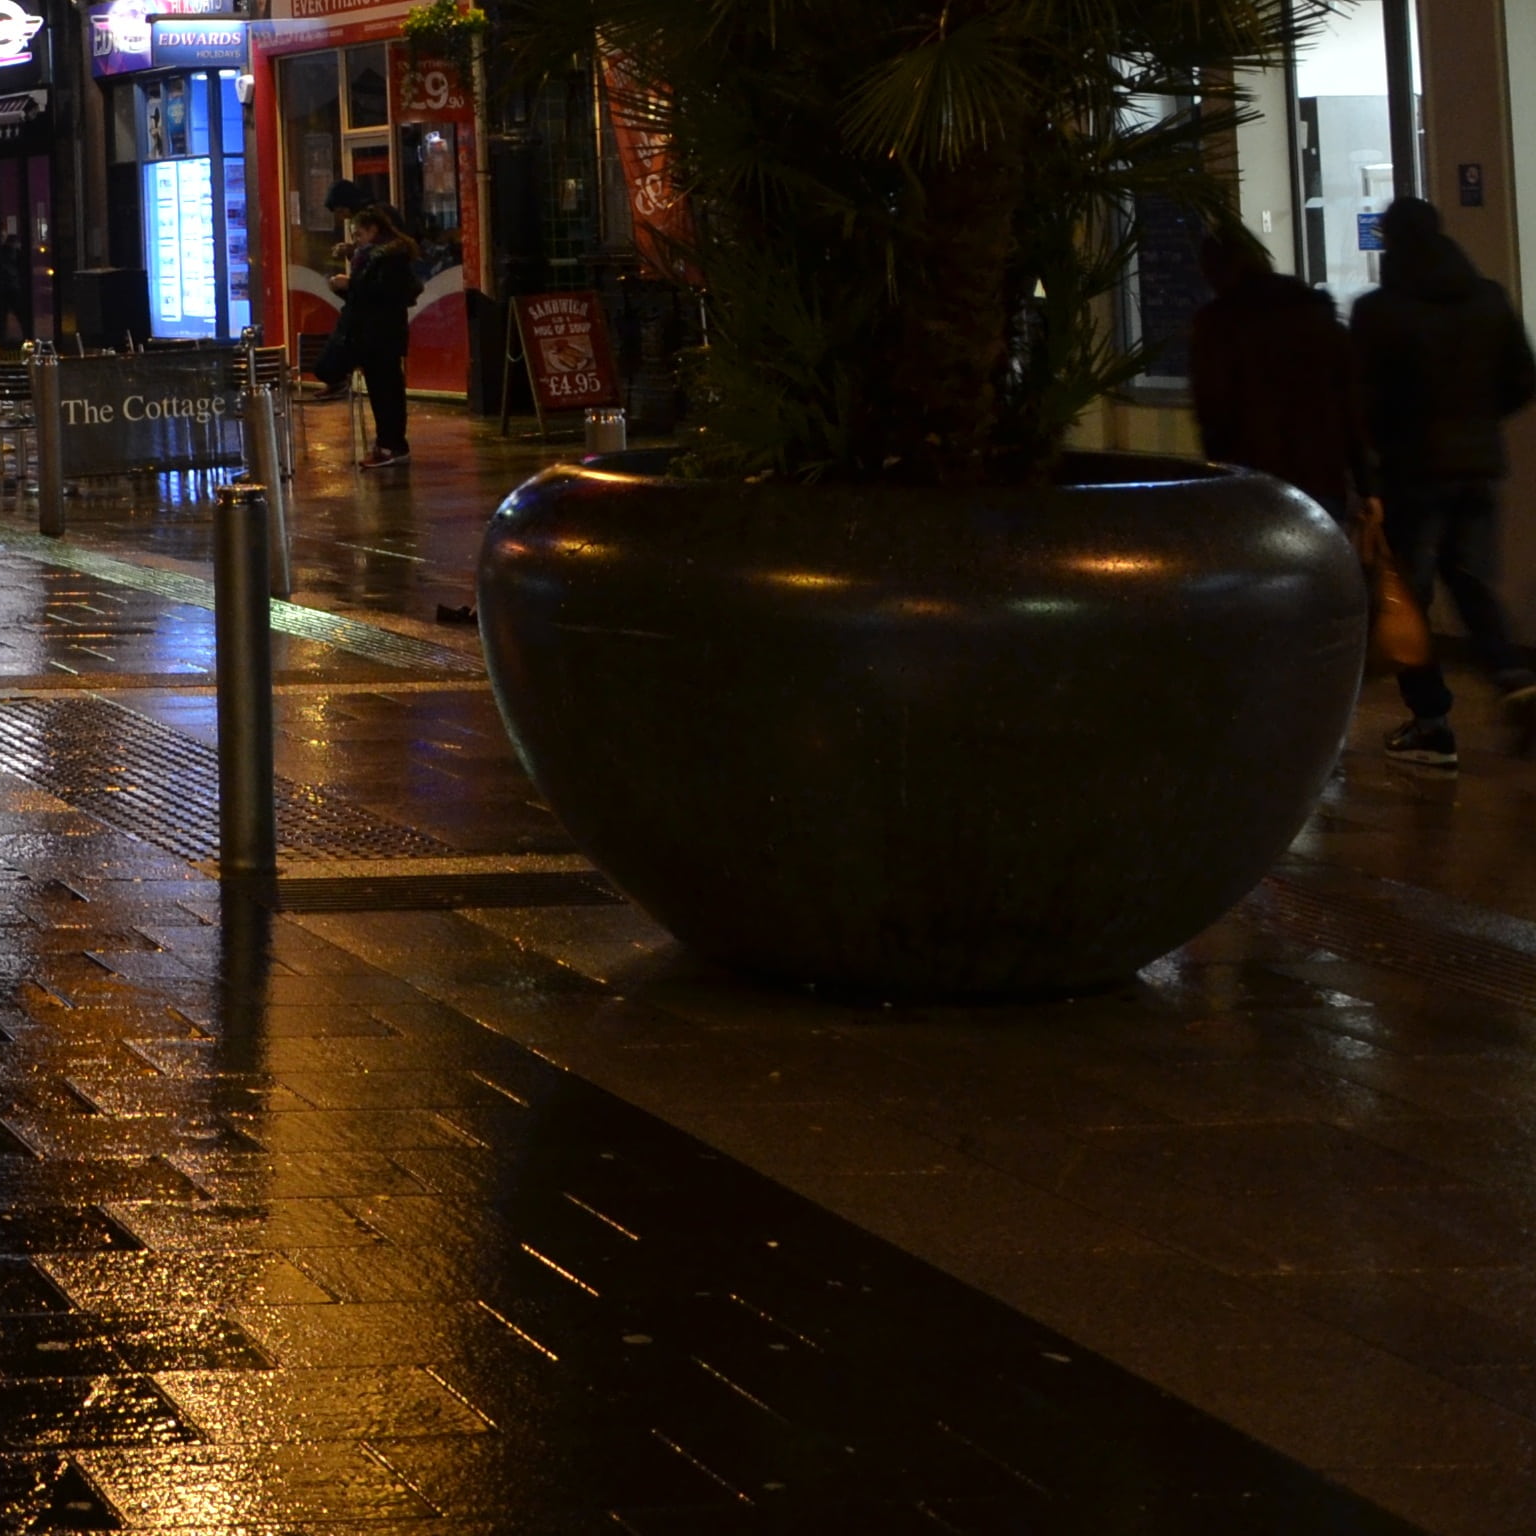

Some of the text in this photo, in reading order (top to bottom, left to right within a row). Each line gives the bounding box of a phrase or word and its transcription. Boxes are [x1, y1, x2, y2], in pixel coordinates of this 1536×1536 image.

[158, 31, 242, 46] EDWARDS
[196, 50, 242, 59] HOLIDAYS
[528, 297, 589, 321] SANDWICH
[549, 372, 601, 397] £4.95
[61, 395, 226, 425] The Cottage
